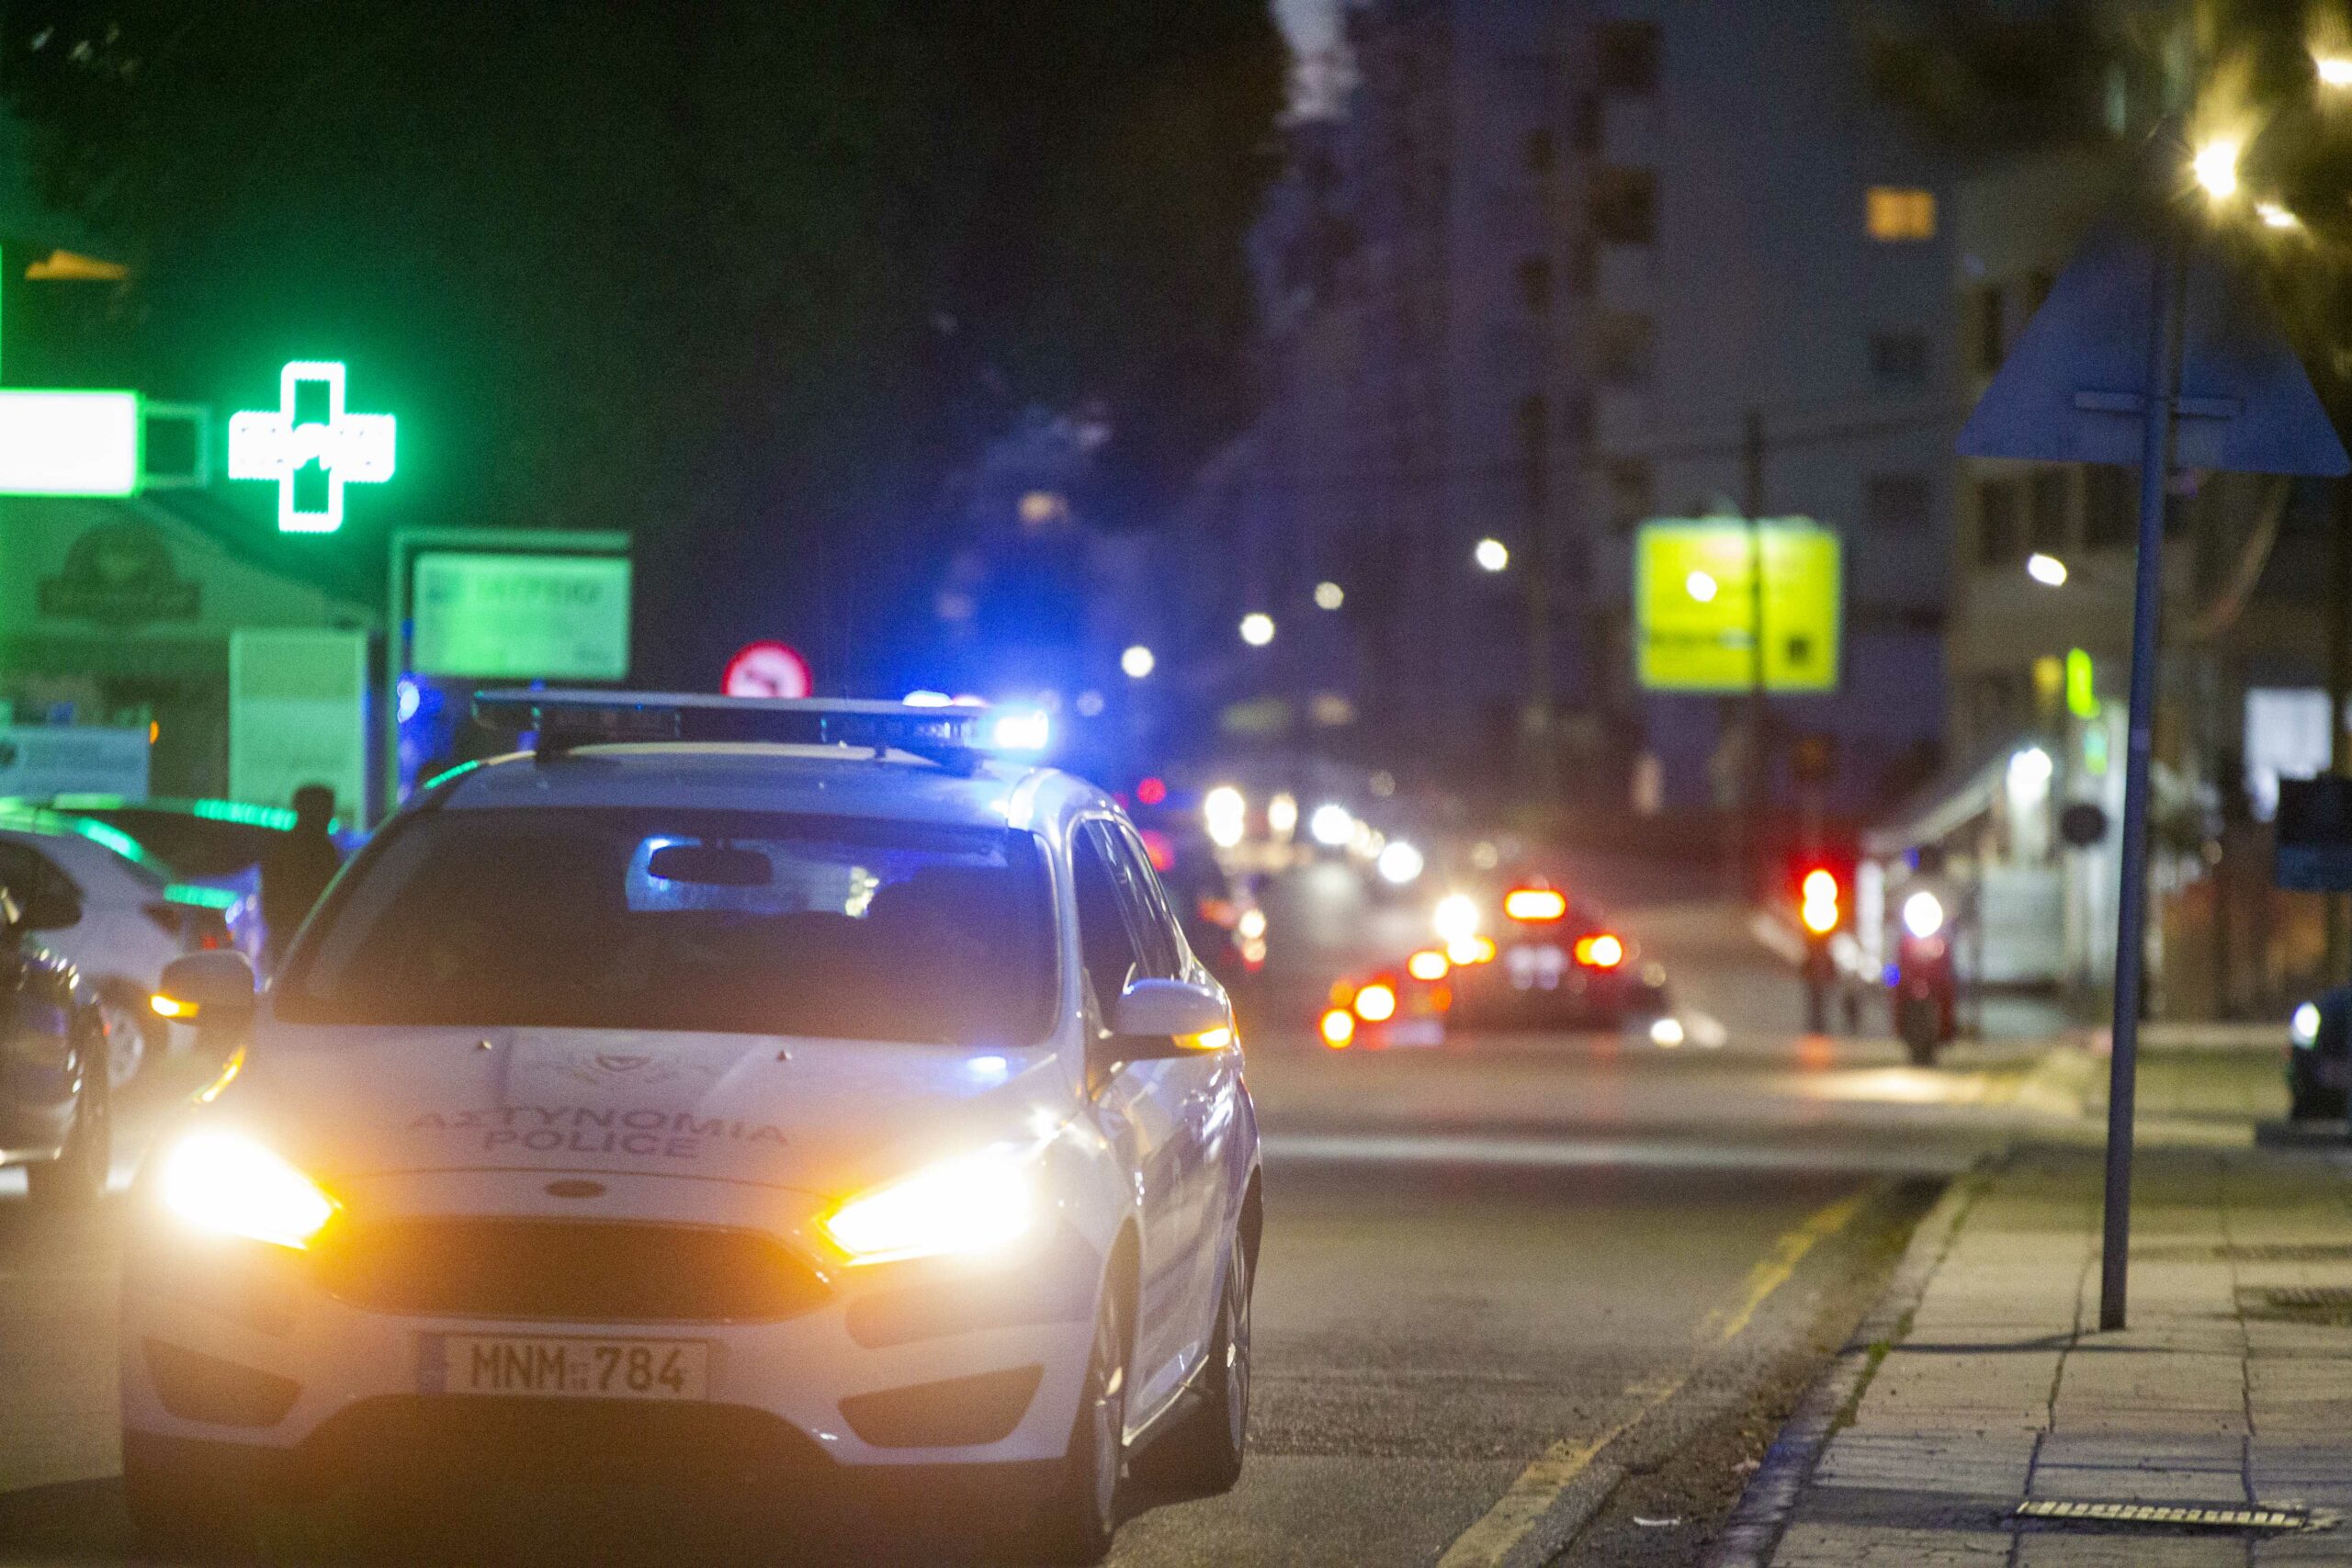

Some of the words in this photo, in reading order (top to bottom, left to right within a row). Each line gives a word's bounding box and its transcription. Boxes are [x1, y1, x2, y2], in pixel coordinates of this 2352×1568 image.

[413, 1106, 788, 1145] ΑΣΤΥΝΟΜΙΑ
[482, 1129, 698, 1158] POLICE
[469, 1344, 566, 1390] MNM
[595, 1346, 686, 1393] 784
